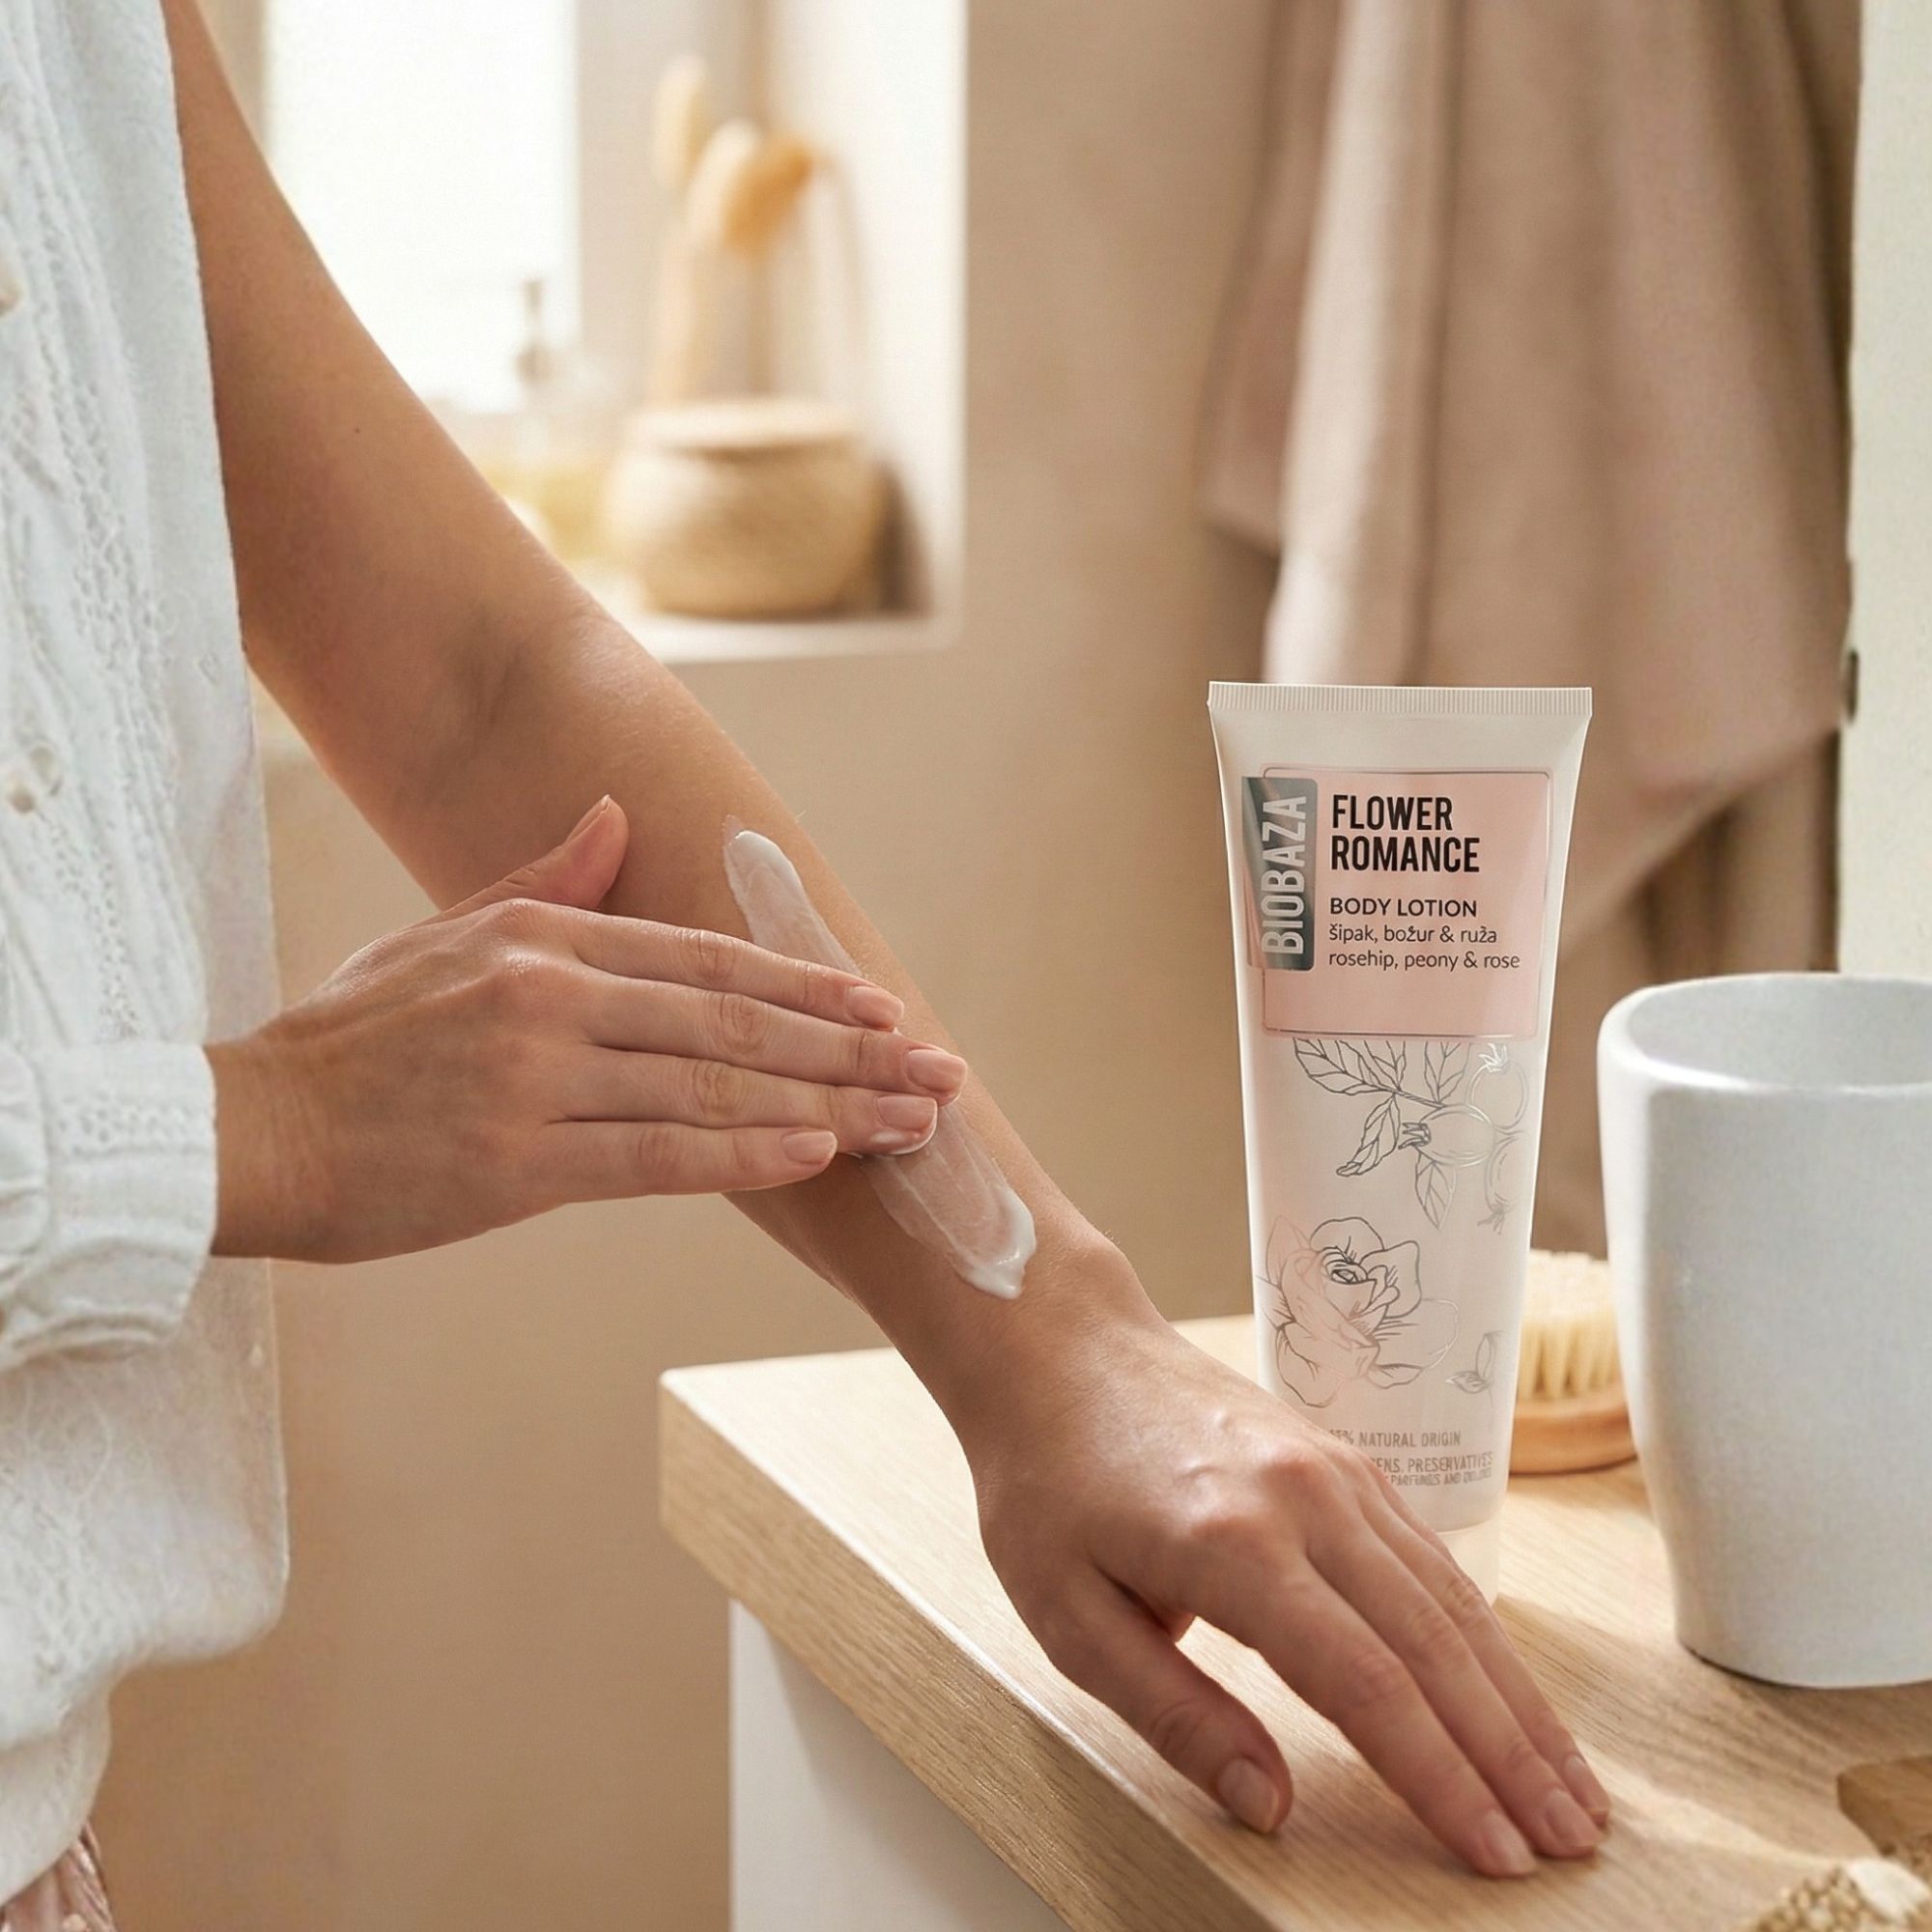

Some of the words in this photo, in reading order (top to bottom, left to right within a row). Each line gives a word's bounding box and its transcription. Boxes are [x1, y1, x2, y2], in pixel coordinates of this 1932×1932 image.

[1332, 794, 1453, 831] FLOWER
[1330, 836, 1481, 872] ROMANCE
[1261, 796, 1306, 954] BIOBAZA
[1330, 897, 1391, 916] BODY
[1397, 899, 1477, 918] LOTION
[1329, 924, 1378, 944] šipak,
[1384, 924, 1435, 943] božur
[1440, 926, 1454, 943] &
[1461, 925, 1497, 943] ruža
[1329, 951, 1399, 971] rosehip,
[1405, 954, 1458, 972] peony
[1463, 953, 1477, 969] &
[1484, 953, 1520, 969] rose
[1359, 1431, 1416, 1447] NATURAL
[1422, 1430, 1462, 1447] ORIGIN
